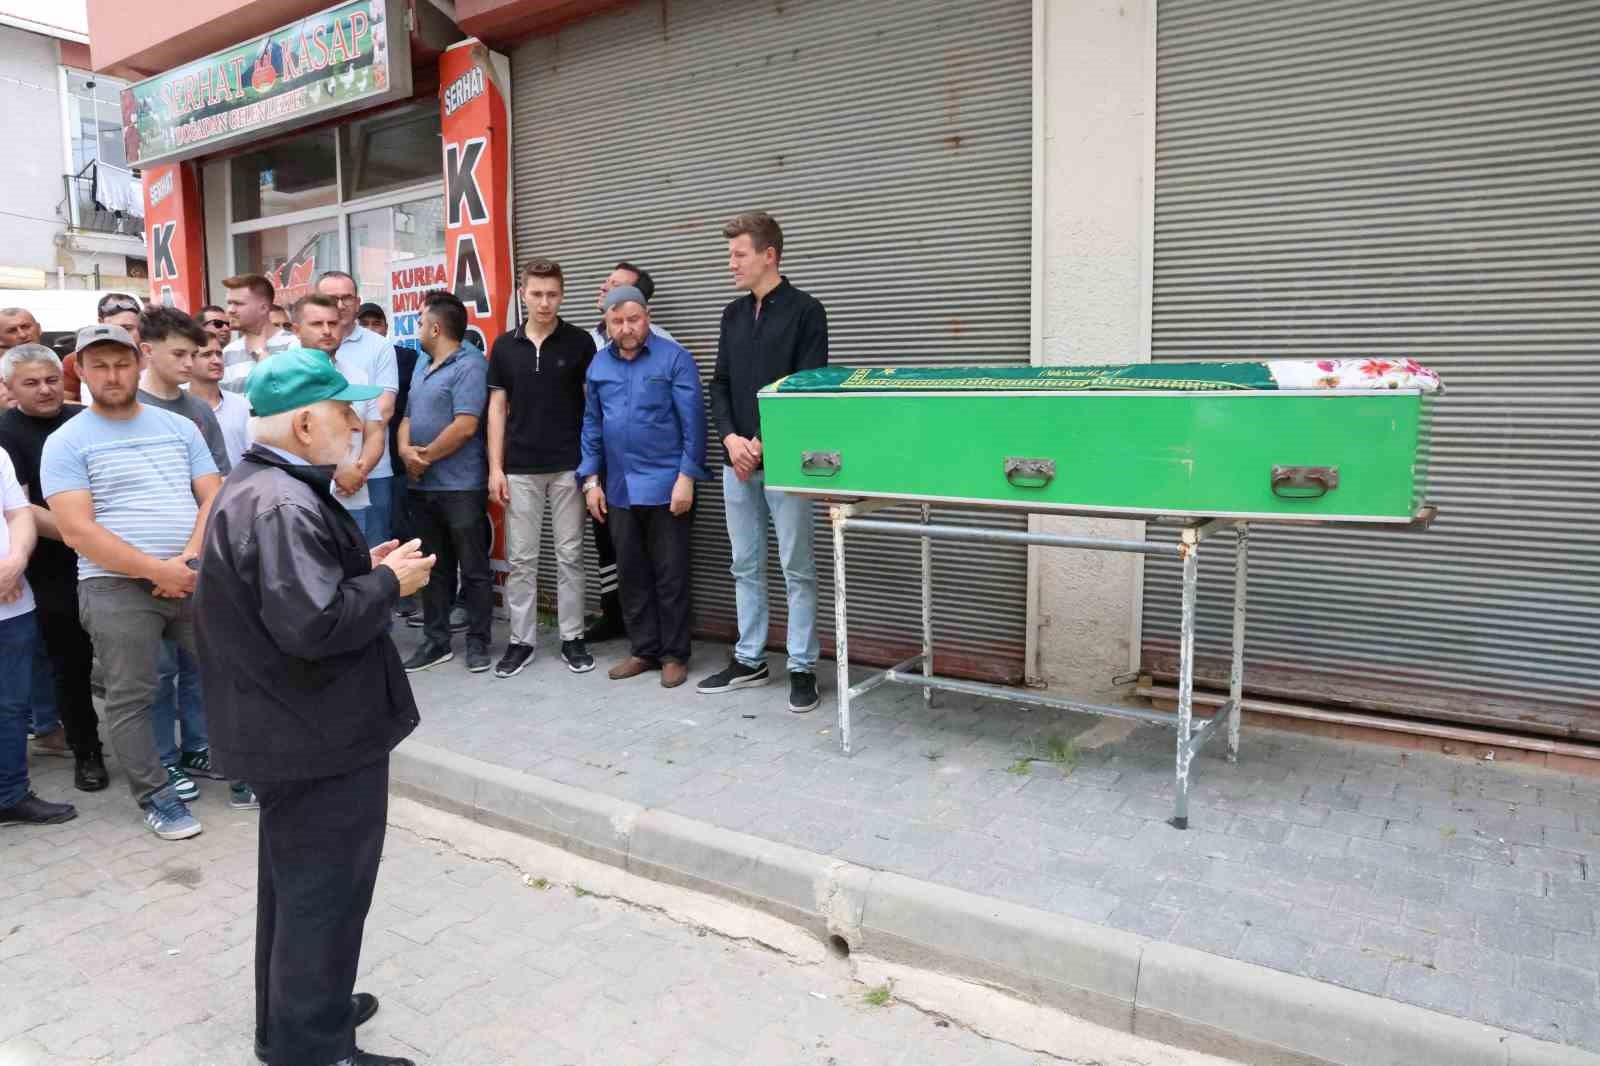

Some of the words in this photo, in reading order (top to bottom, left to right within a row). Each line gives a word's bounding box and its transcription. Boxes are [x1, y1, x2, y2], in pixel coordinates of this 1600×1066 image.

[161, 57, 245, 115] SERHAT
[280, 10, 369, 81] KASAP
[444, 65, 483, 116] SERHAT
